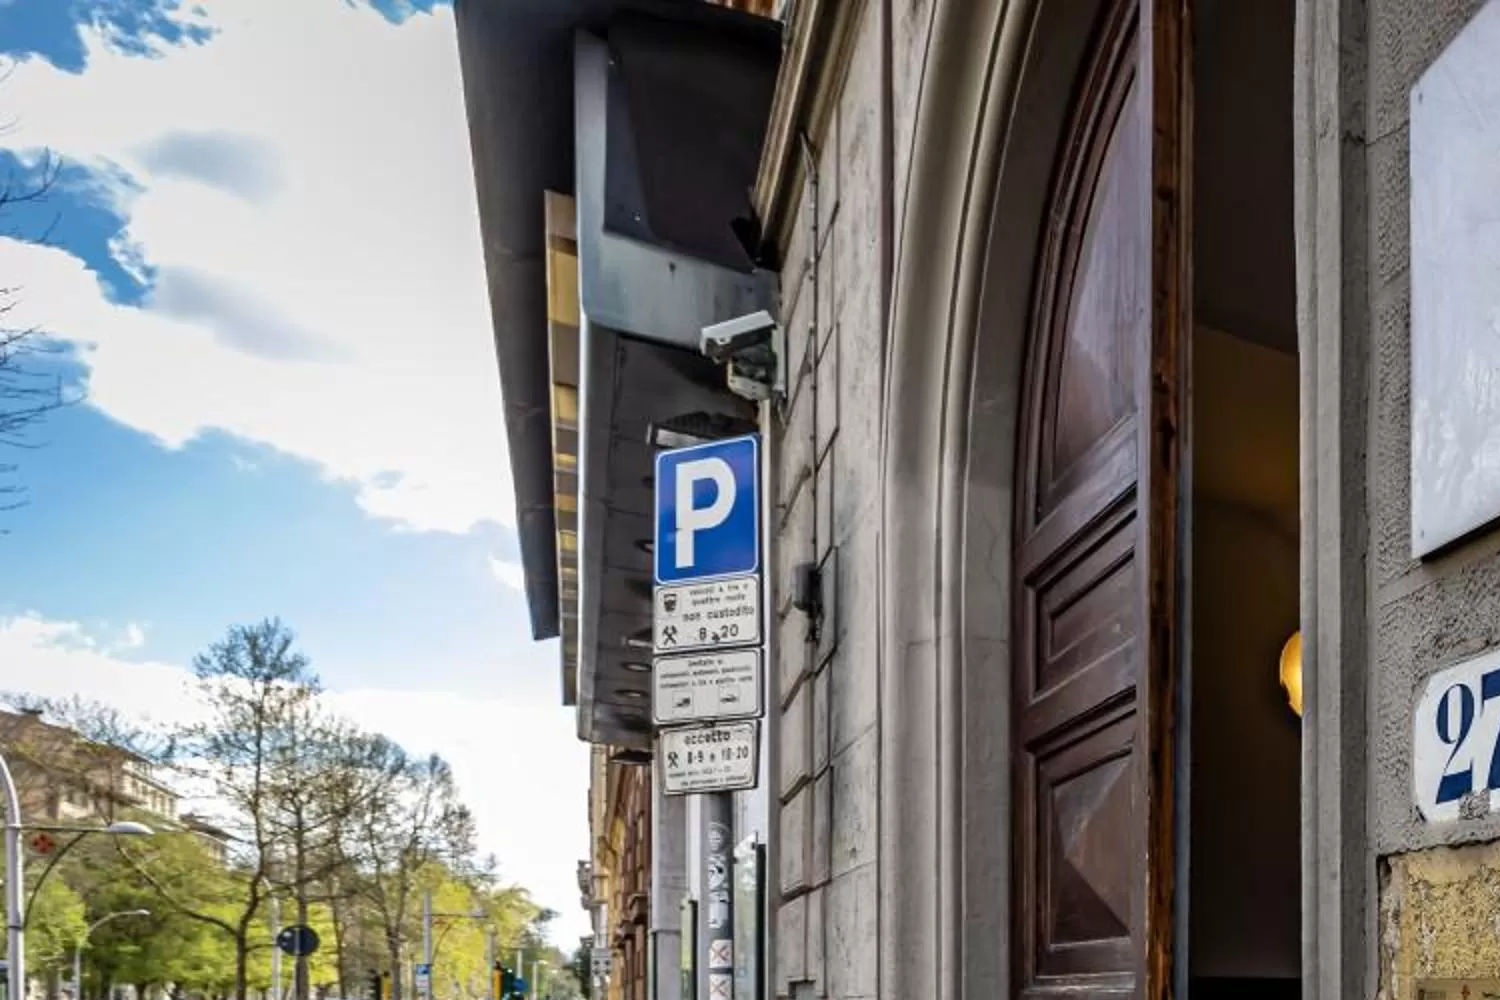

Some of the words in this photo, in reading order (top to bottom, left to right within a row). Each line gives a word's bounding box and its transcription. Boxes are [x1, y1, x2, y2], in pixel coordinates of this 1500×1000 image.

[675, 457, 736, 568] P
[720, 623, 739, 638] 20
[683, 729, 731, 745] eccetto
